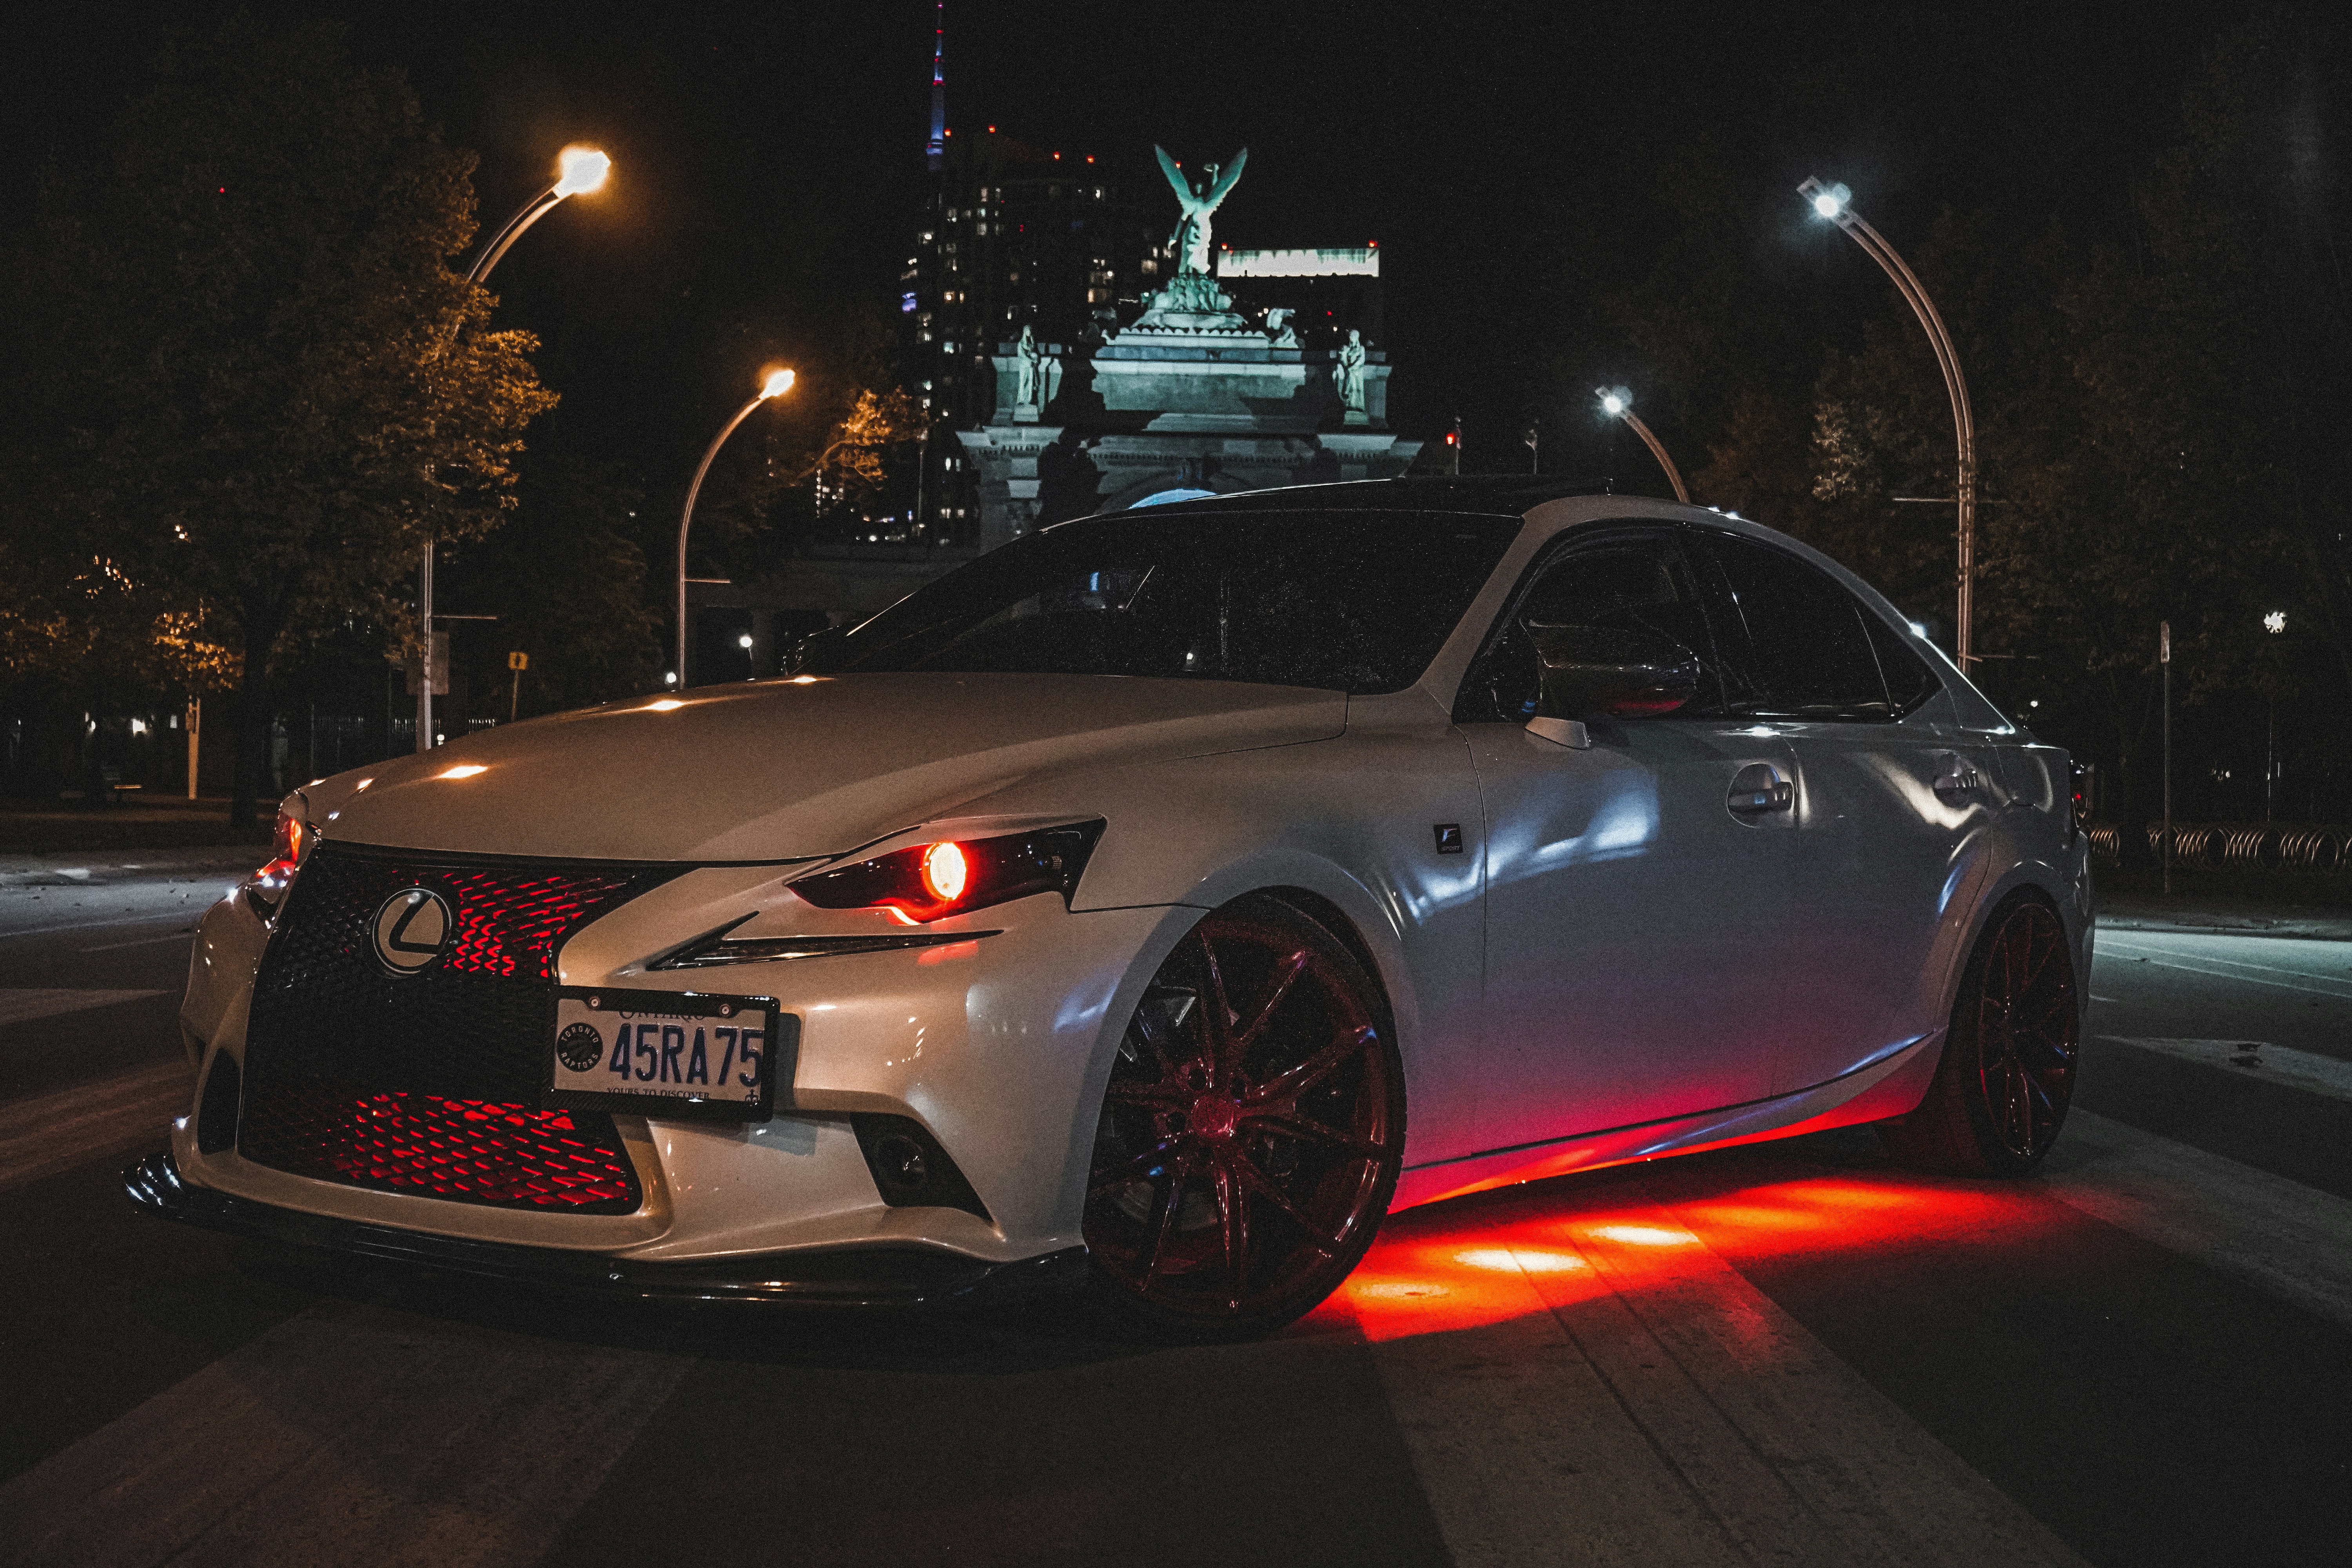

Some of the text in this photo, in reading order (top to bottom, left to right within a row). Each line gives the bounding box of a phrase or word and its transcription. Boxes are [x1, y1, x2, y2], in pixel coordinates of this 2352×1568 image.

[561, 1025, 599, 1043] TORONTO
[561, 1052, 599, 1069] RAPTORS
[609, 1023, 764, 1087] 45RA75
[660, 1090, 710, 1099] DISCOVER
